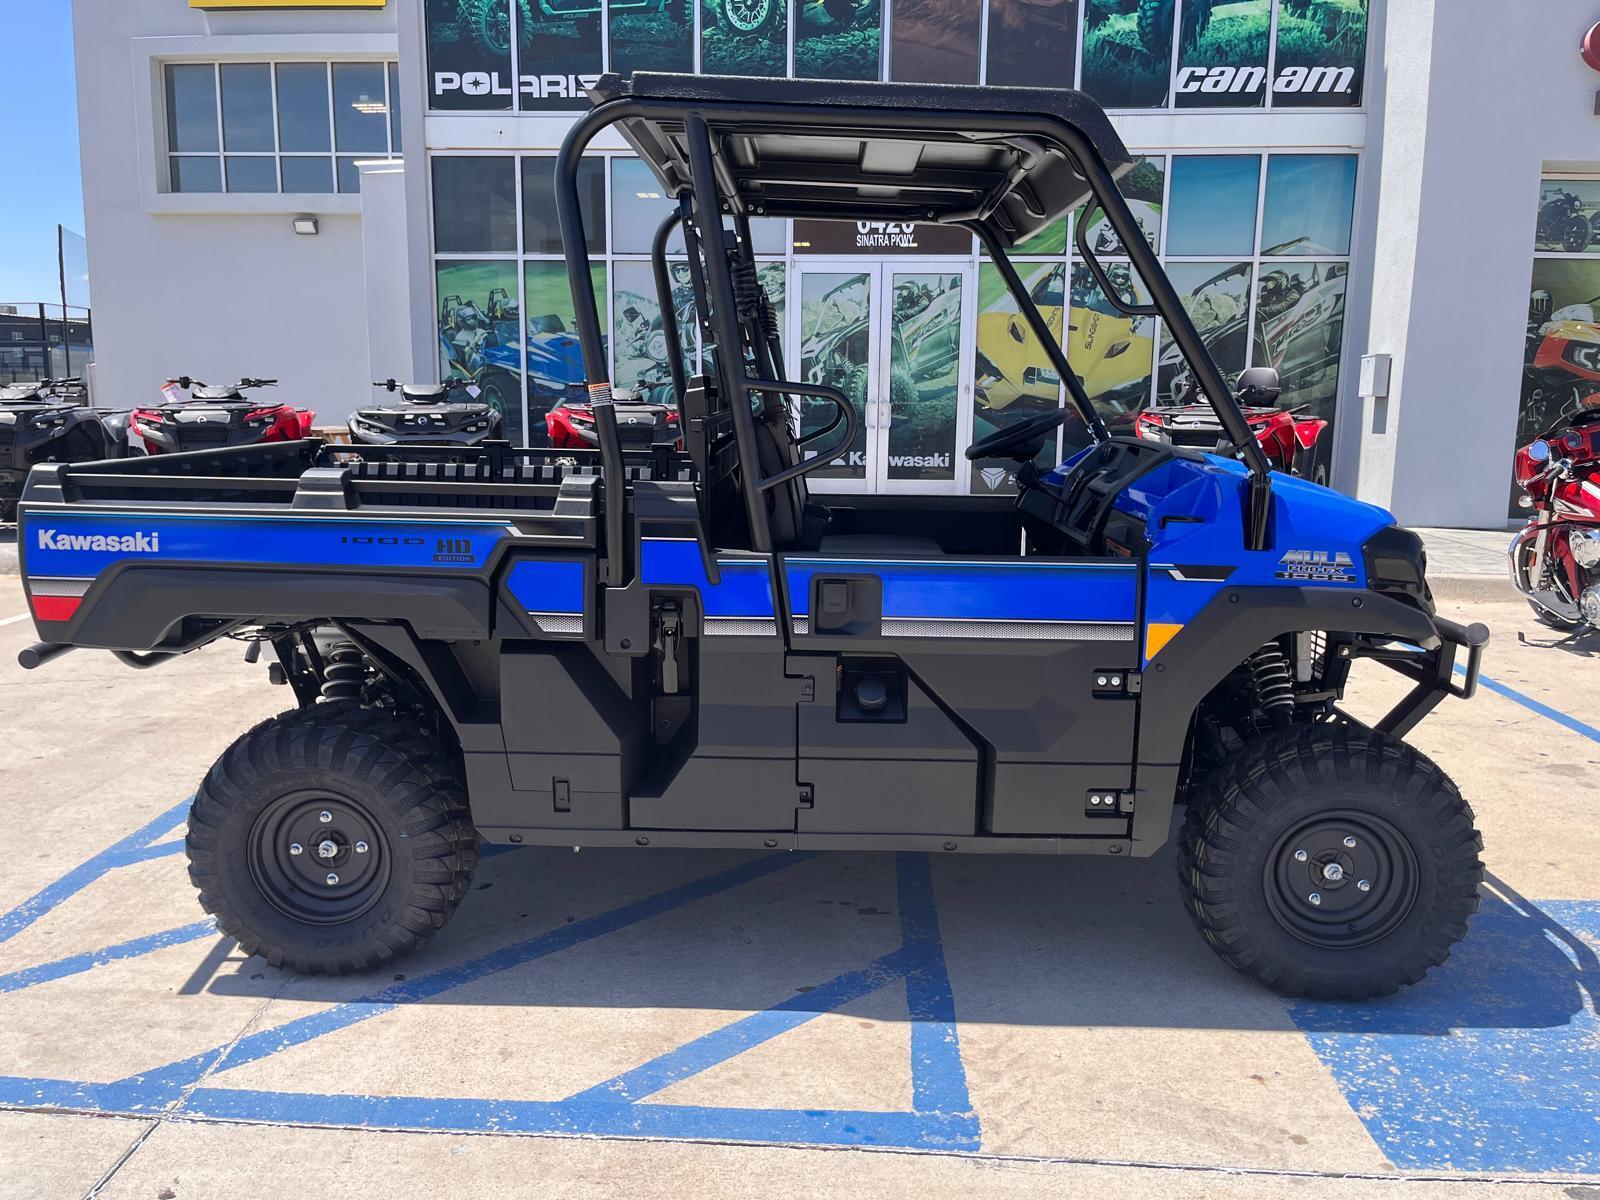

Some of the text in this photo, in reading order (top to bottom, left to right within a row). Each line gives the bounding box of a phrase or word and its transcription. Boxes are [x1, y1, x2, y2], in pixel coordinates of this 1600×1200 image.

[434, 71, 602, 98] POLARIS
[856, 234, 914, 247] SINATRA PKWY
[38, 529, 159, 552] Kawasaki
[437, 538, 471, 554] HD
[1280, 550, 1355, 568] MULE
